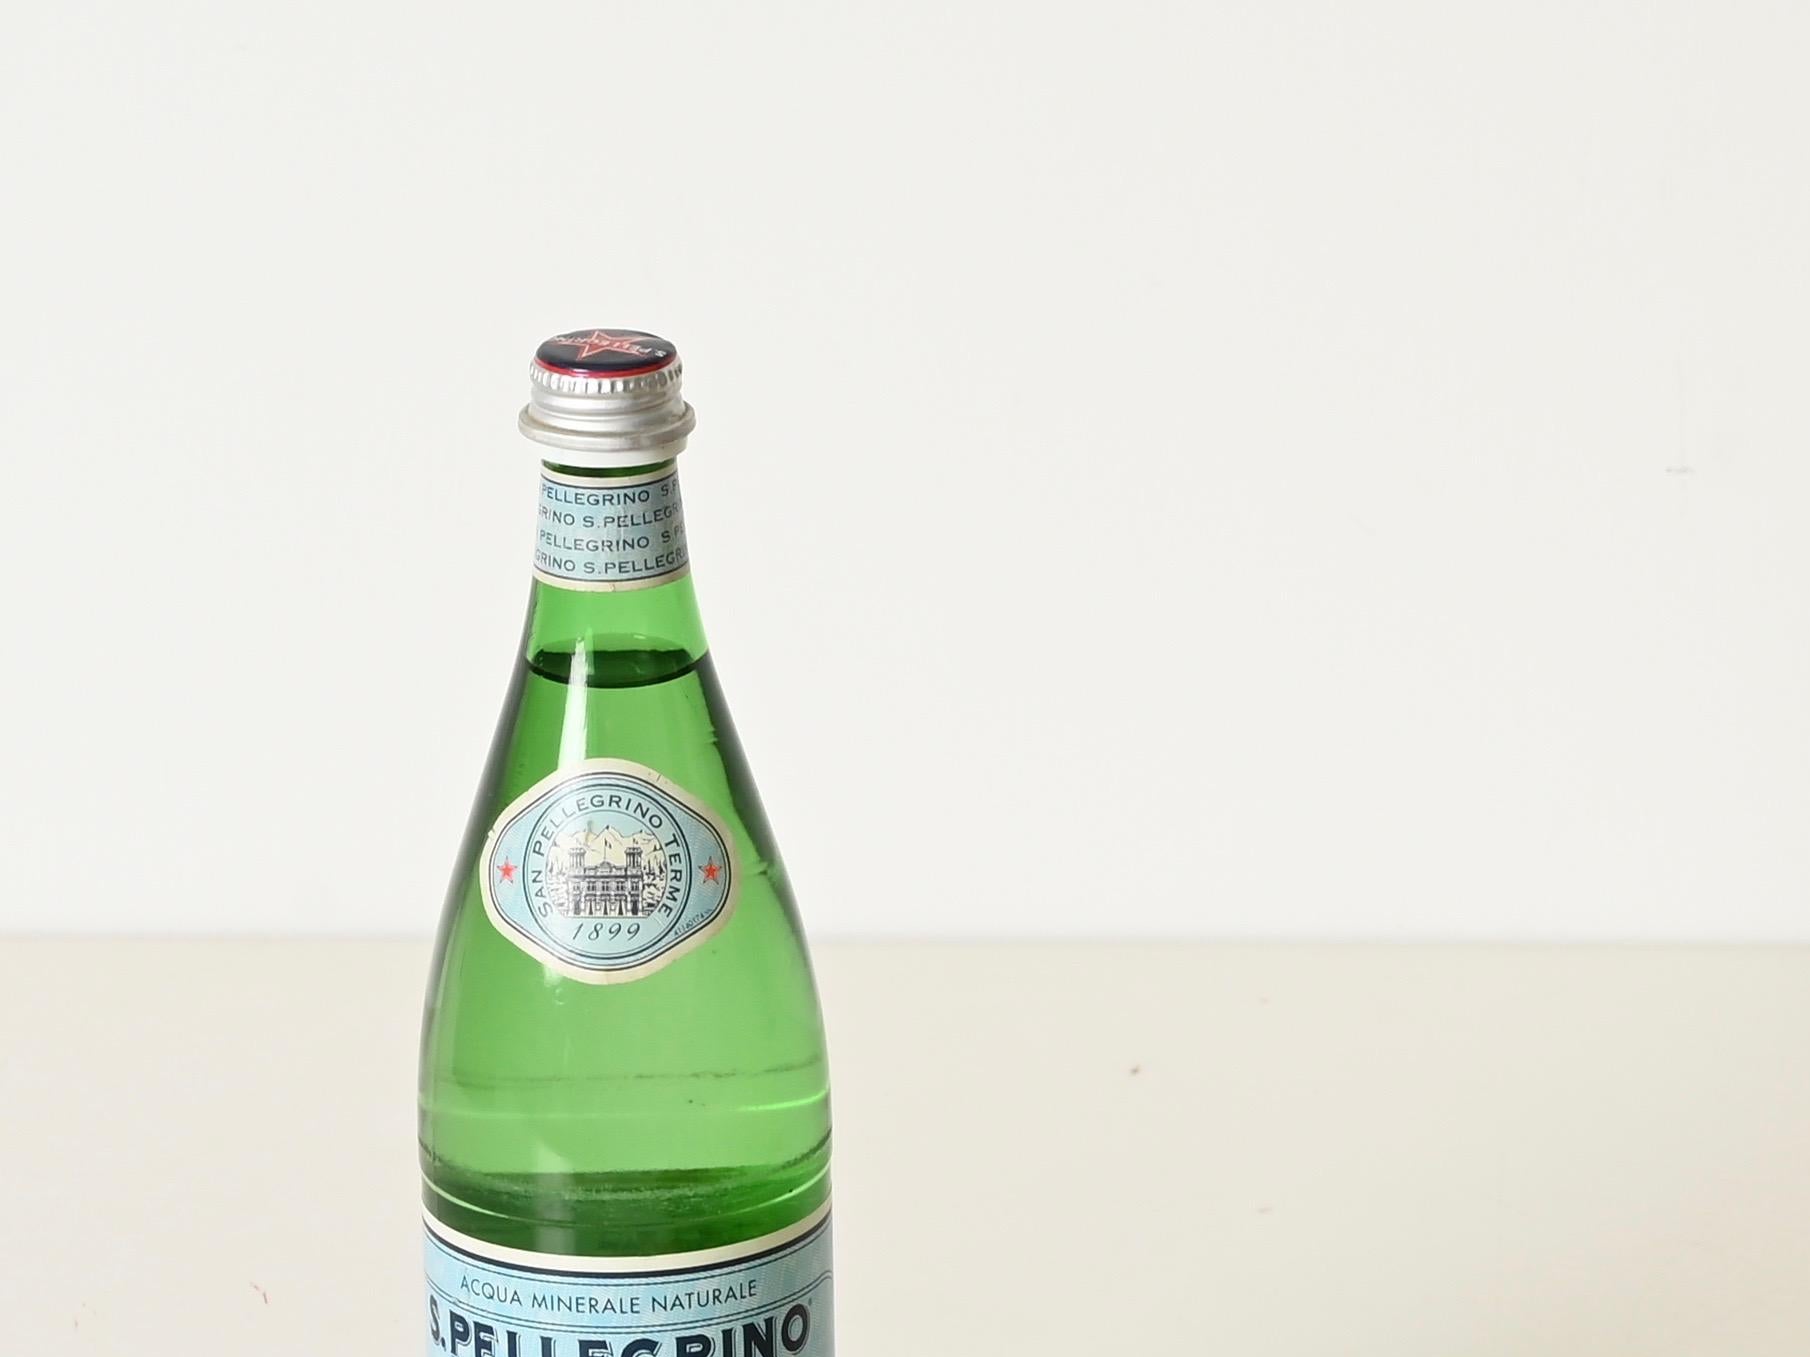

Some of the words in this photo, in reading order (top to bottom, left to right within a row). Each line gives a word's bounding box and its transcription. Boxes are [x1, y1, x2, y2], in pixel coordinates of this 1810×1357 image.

[539, 529, 650, 552] PELLEGRINO
[532, 794, 663, 857] PELLEGRINO
[531, 870, 553, 918] SAN
[659, 833, 683, 919] TERME
[572, 922, 641, 942] 1899
[460, 1275, 522, 1306] ACQUA
[531, 1293, 641, 1314] MINERALE
[651, 1279, 757, 1312] NATURALE
